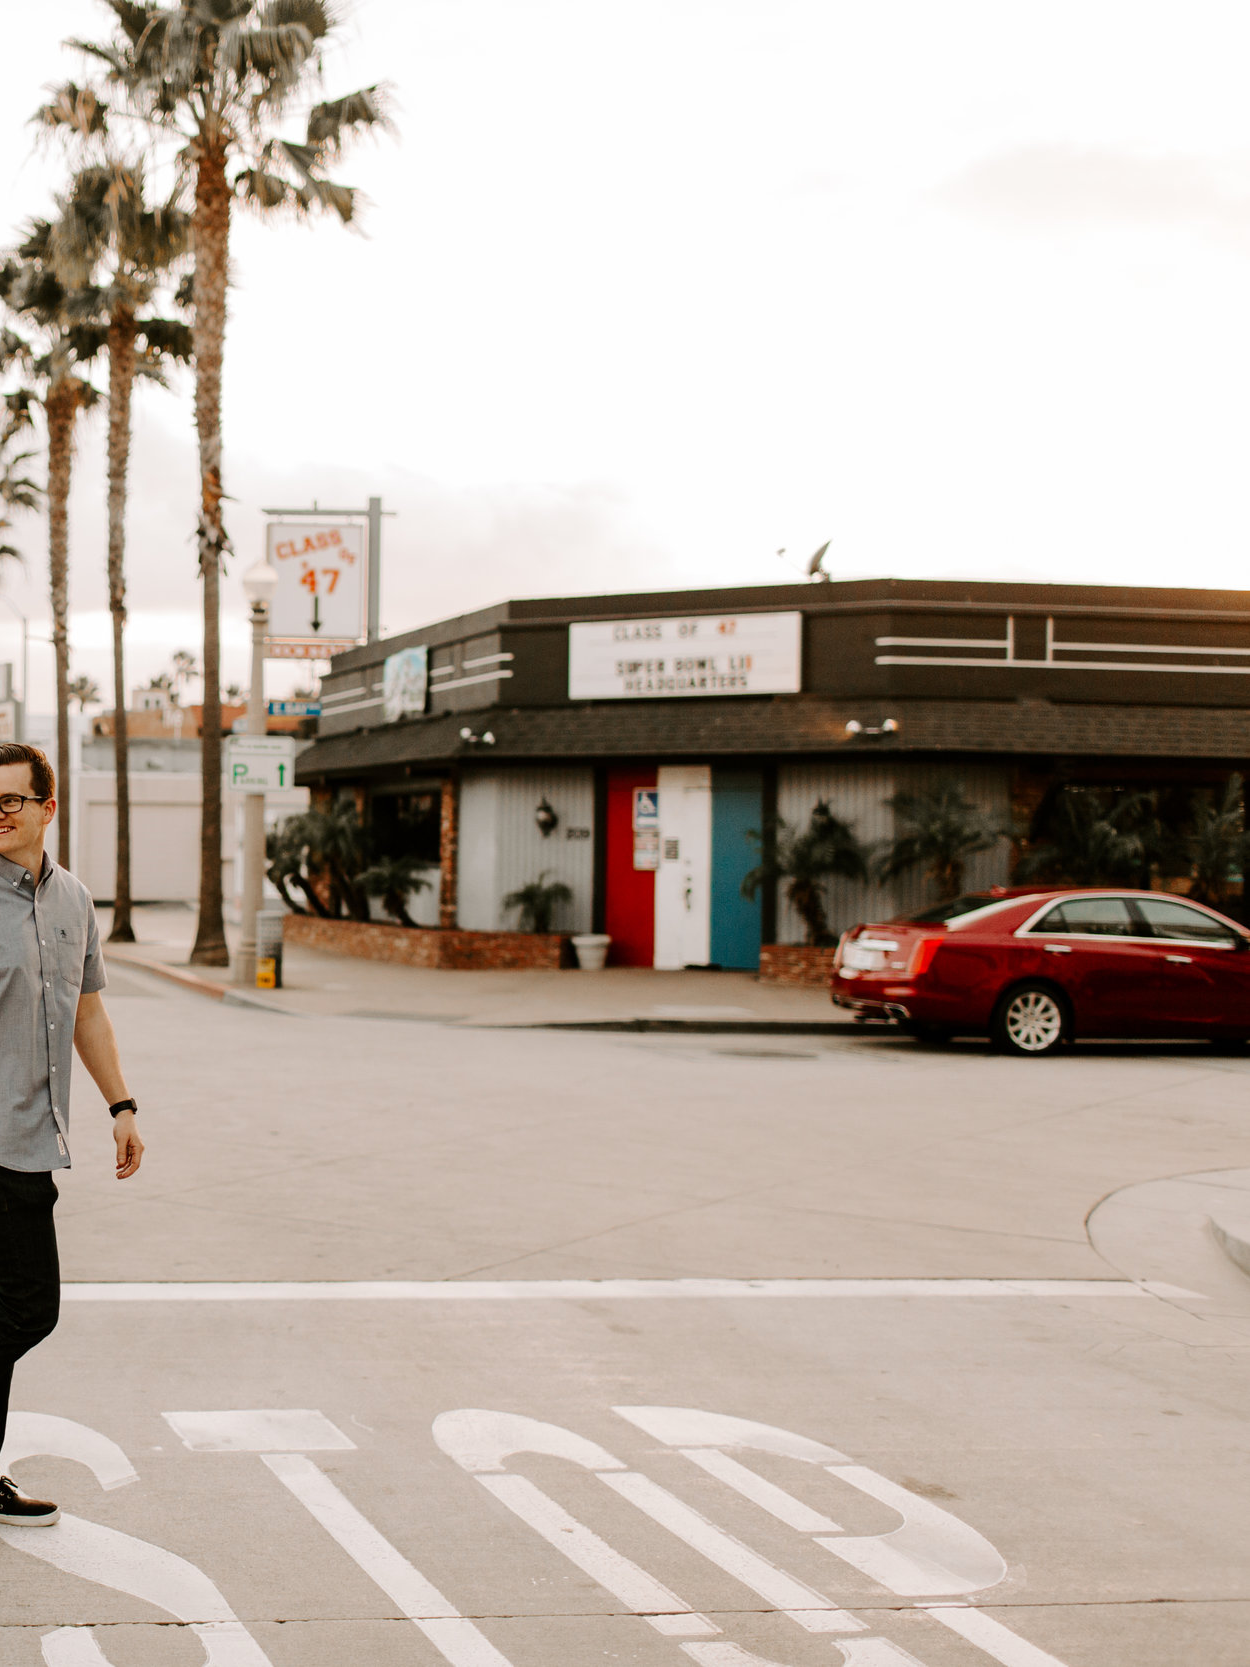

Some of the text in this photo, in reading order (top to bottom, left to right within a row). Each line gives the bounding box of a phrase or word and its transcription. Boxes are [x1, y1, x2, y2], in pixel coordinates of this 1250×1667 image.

[275, 529, 342, 561] CLASS
[613, 625, 662, 642] CLASS
[678, 623, 698, 638] OF
[615, 658, 665, 675] SUPER
[675, 656, 717, 672] BOWL
[624, 675, 748, 692] HEADQUARTERS
